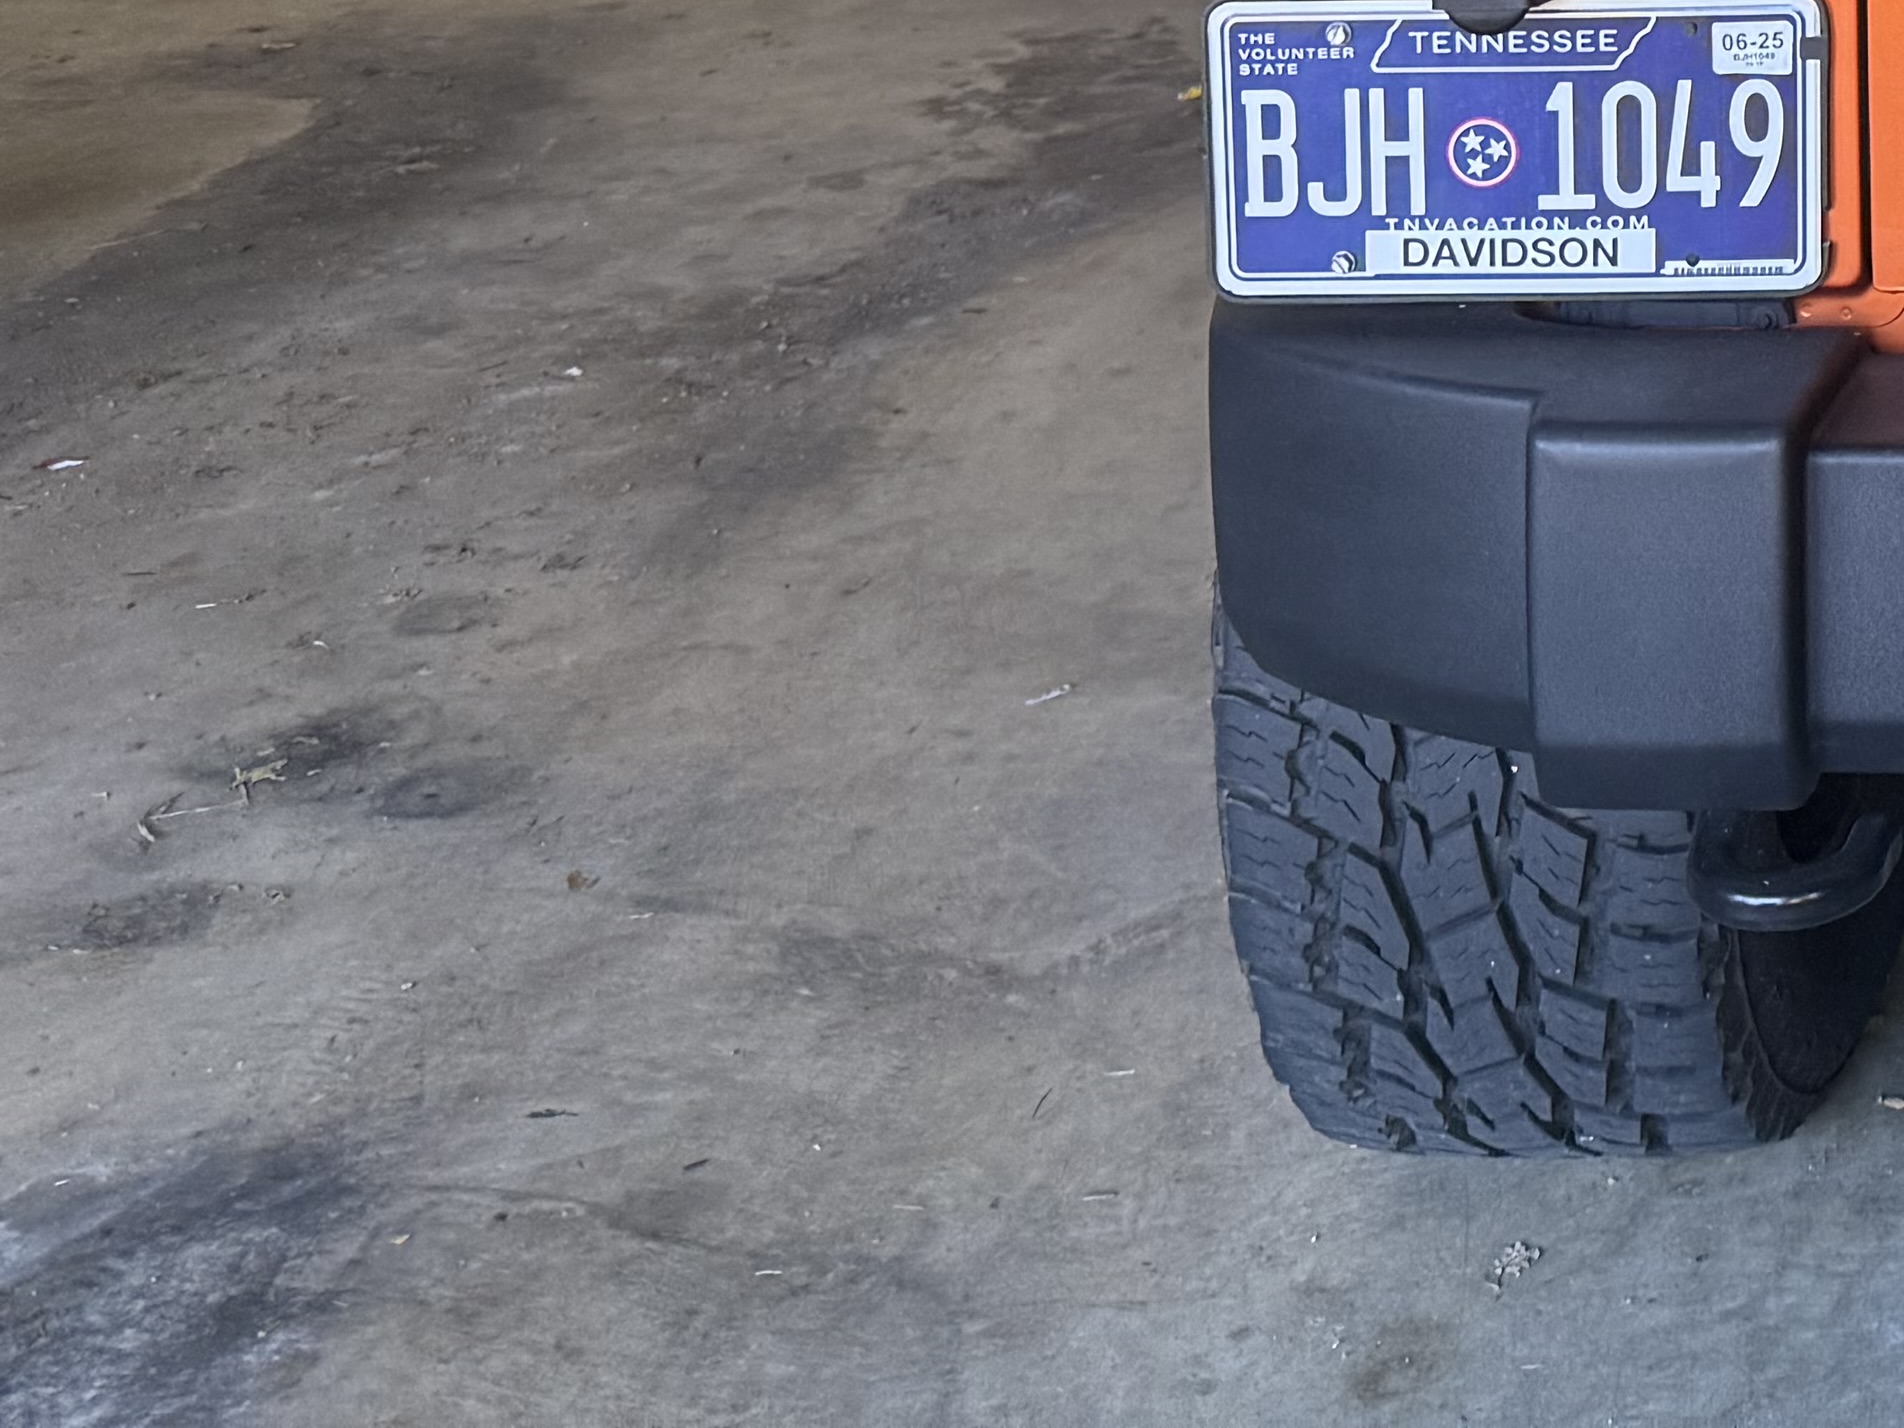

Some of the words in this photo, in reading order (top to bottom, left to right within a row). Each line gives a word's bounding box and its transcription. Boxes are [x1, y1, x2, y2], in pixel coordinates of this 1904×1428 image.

[1237, 32, 1276, 46] THE
[1408, 28, 1620, 55] TENNESSEE
[1722, 31, 1784, 51] 06-25
[1238, 47, 1355, 61] VOLUNTEER
[1238, 63, 1298, 76] STATE
[1241, 87, 1427, 218] BJH
[1537, 78, 1785, 213] 1049
[1384, 215, 1651, 231] TNVACATION.COM
[1402, 236, 1621, 270] DAVIDSON
